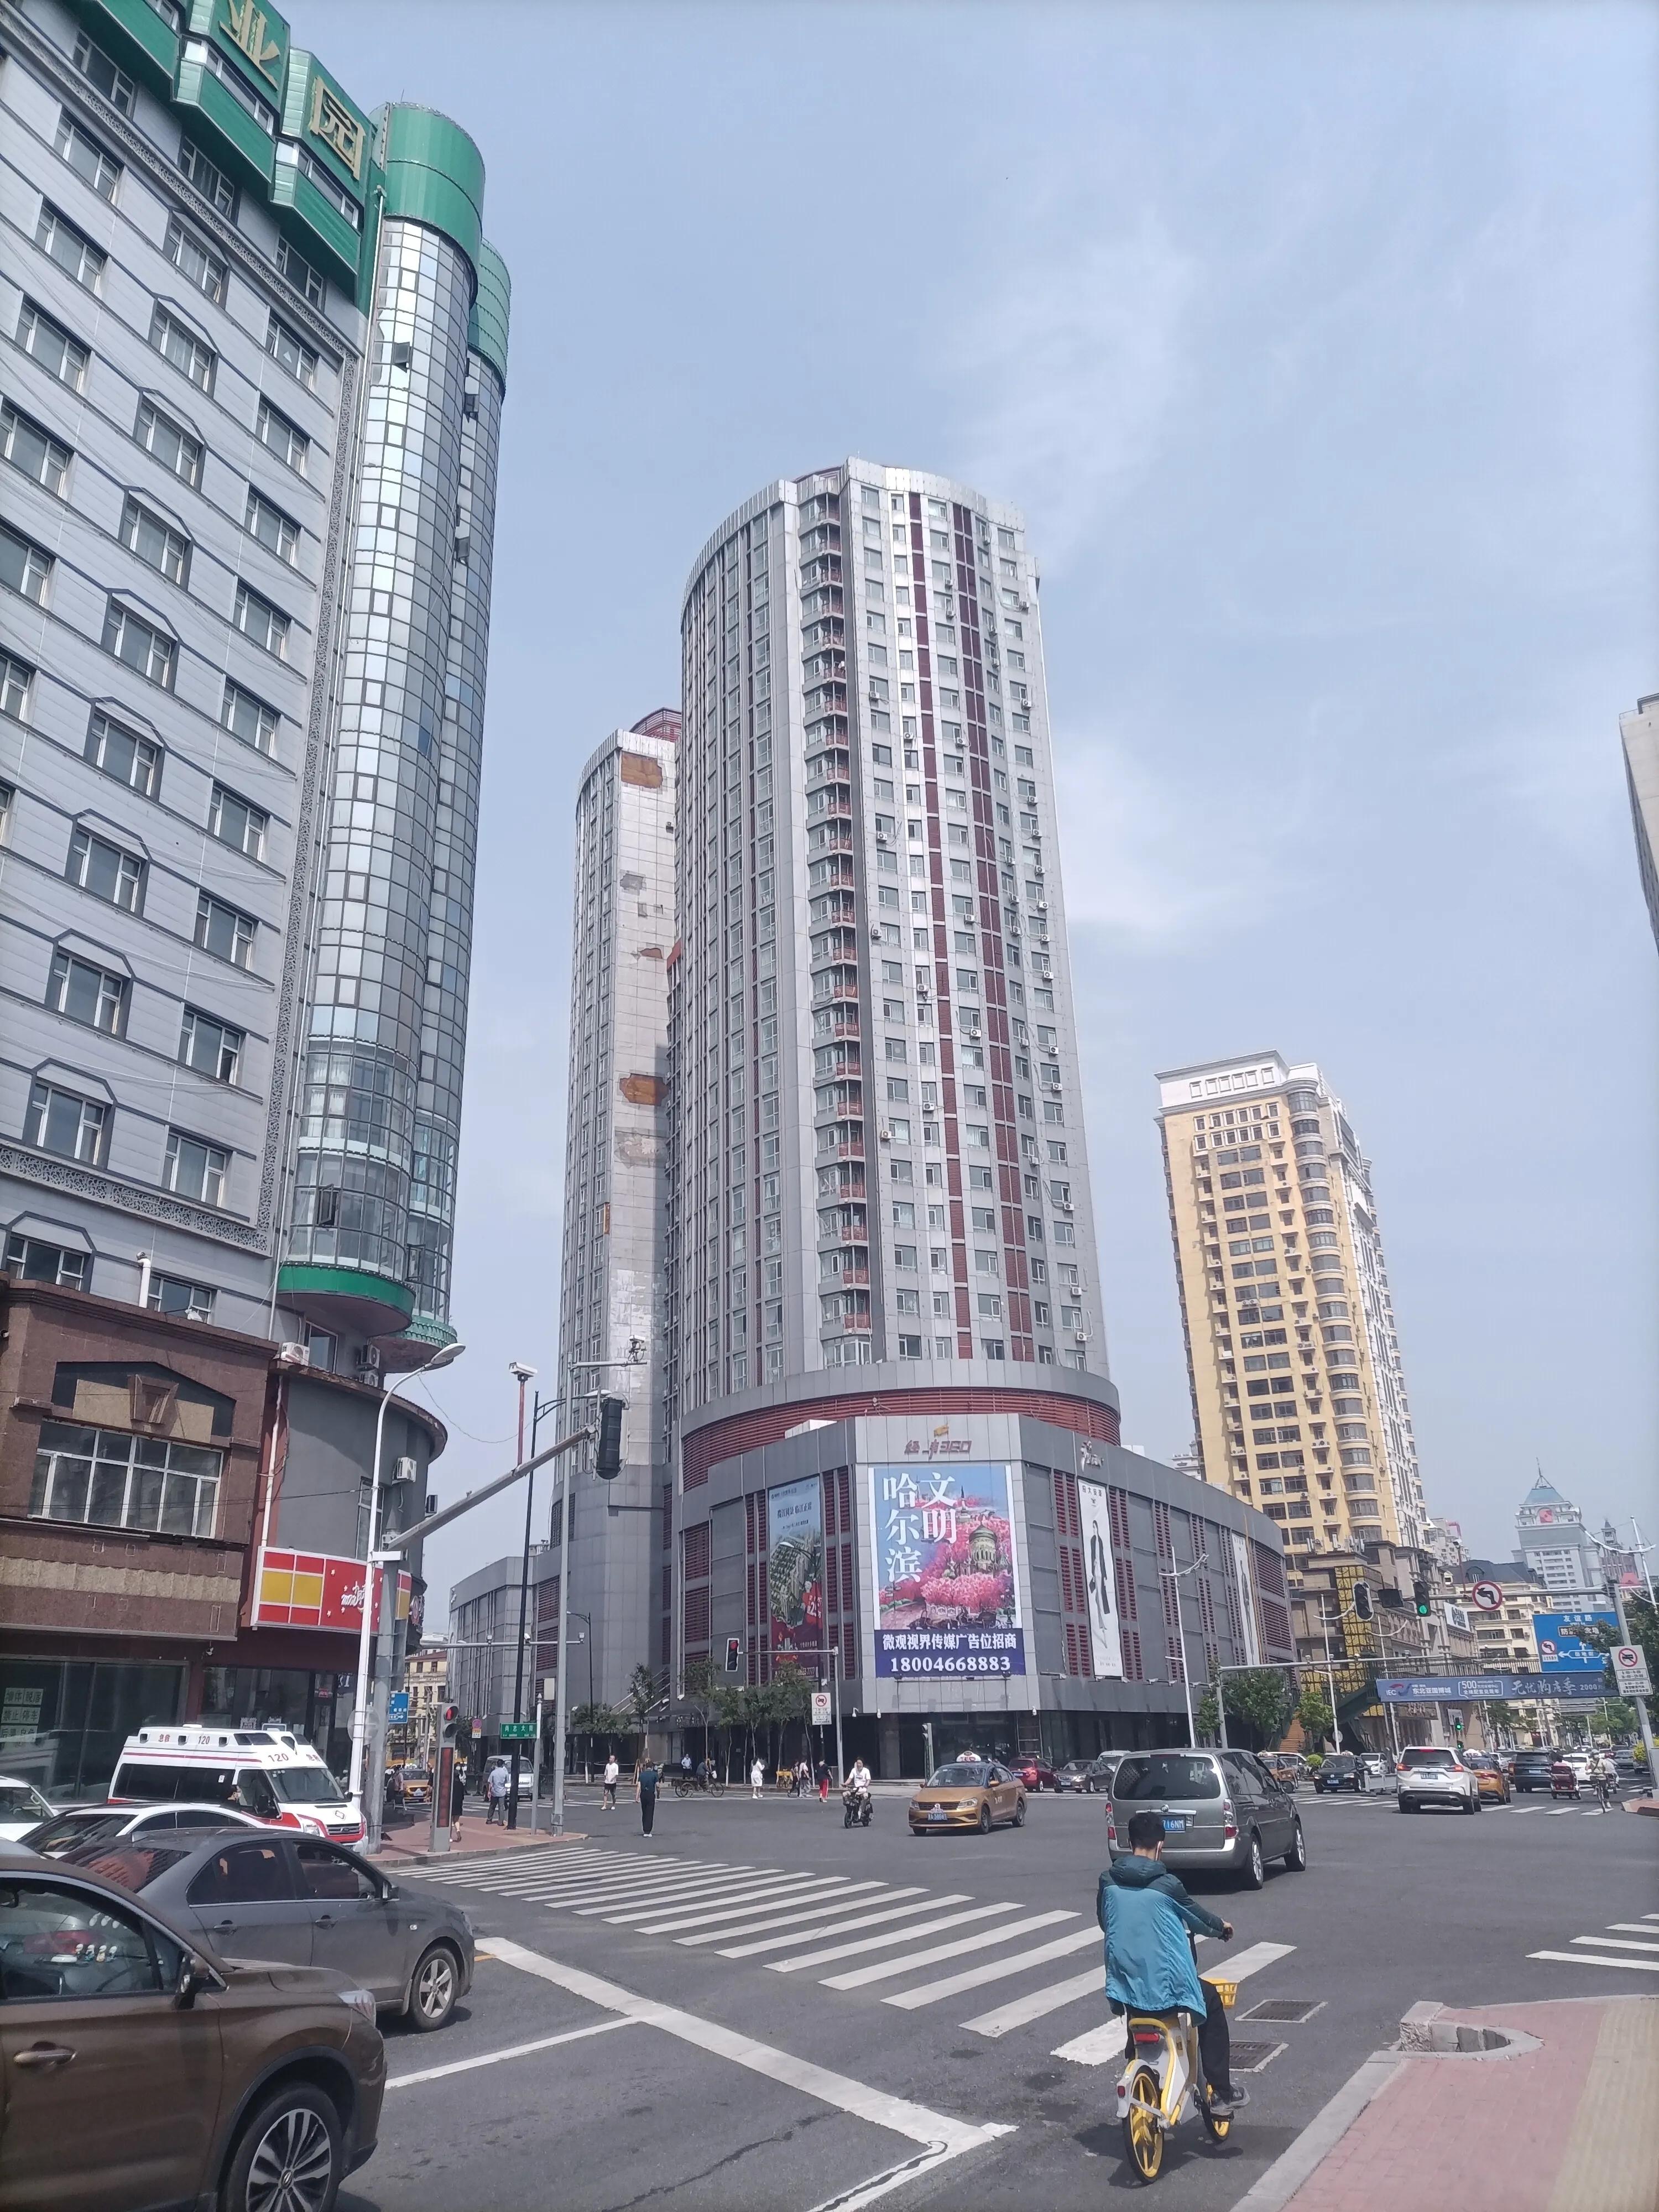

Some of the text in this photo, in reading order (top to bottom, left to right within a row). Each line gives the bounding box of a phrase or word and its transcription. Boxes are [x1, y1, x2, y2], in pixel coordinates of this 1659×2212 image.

[920, 1472, 957, 1544] 文明
[883, 1473, 923, 1583] 哈尔滨
[1563, 1614, 1593, 1623] 友谊路
[883, 1632, 1017, 1651] 微观视界传媒广告位招商
[890, 1656, 1011, 1672] 18004668883
[1461, 1681, 1477, 1689] 500
[3, 1709, 38, 1721] 禁止停车
[197, 1735, 210, 1745] 120
[268, 1753, 289, 1763] 120
